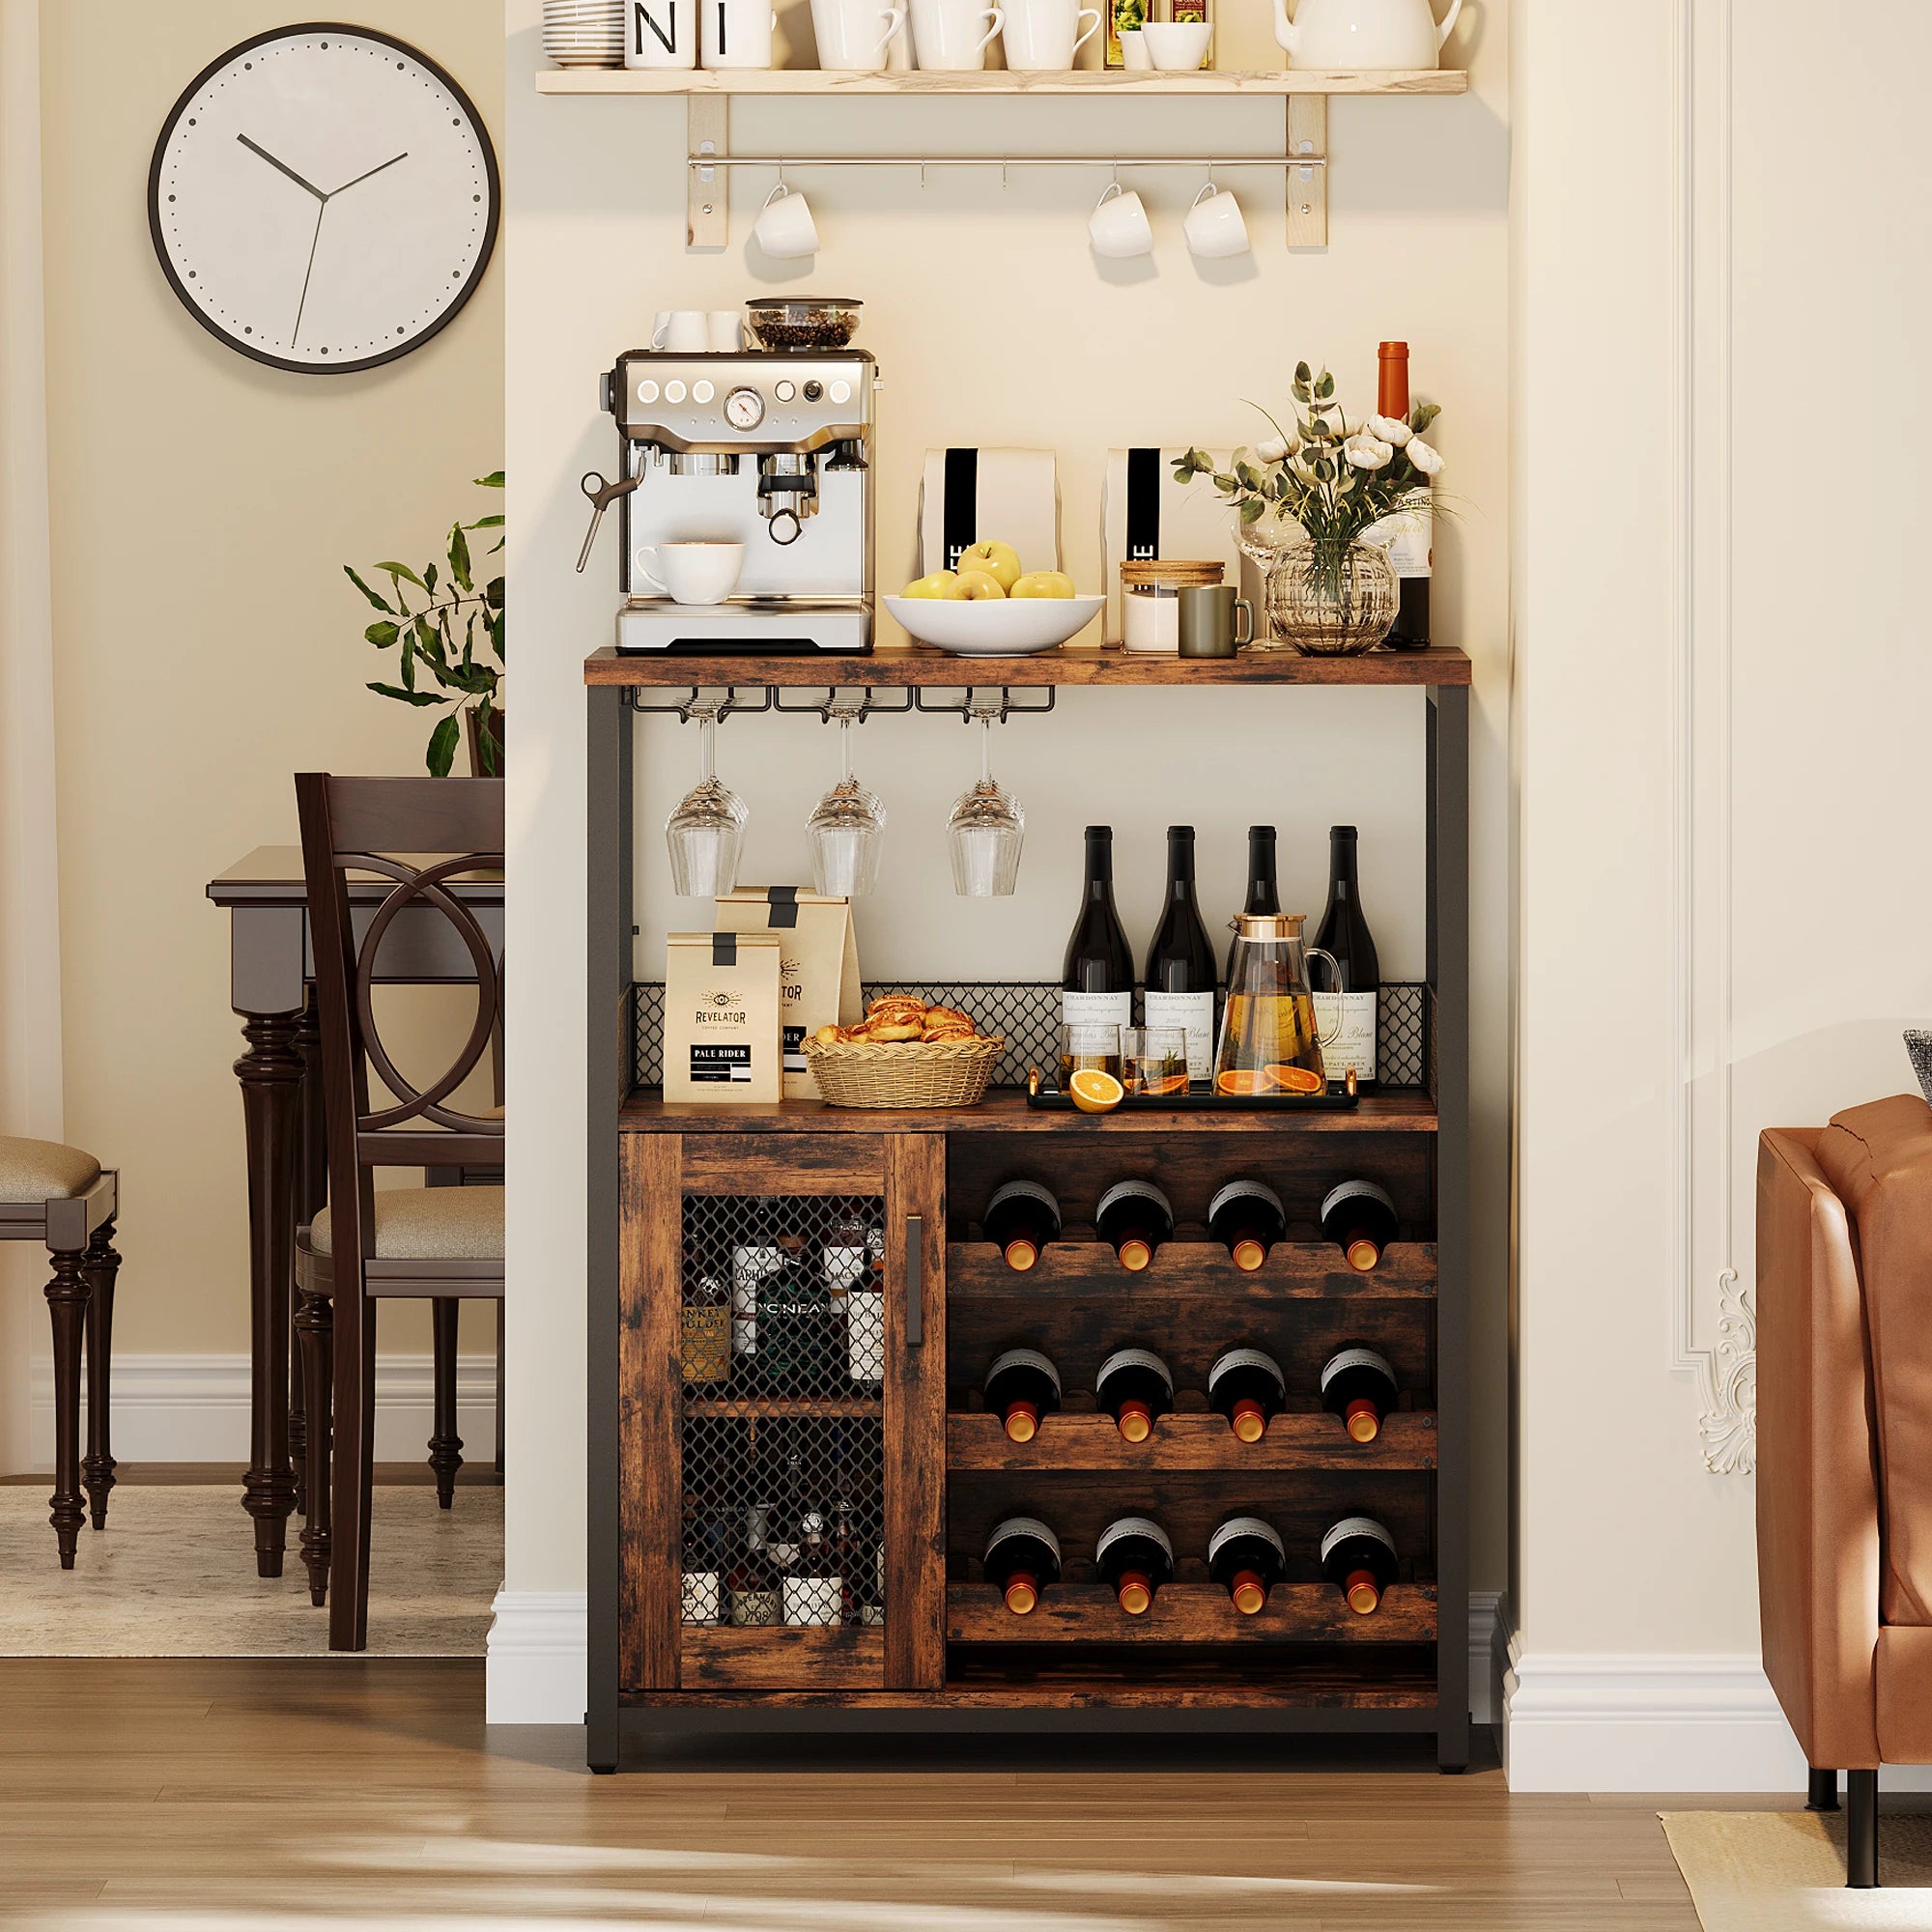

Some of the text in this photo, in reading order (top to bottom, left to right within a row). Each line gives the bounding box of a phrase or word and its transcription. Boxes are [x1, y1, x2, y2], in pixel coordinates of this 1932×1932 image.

[635, 2, 676, 54] N
[719, 3, 725, 54] I
[696, 1010, 746, 1025] REVELATOR
[695, 1049, 746, 1058] PALE RIDER
